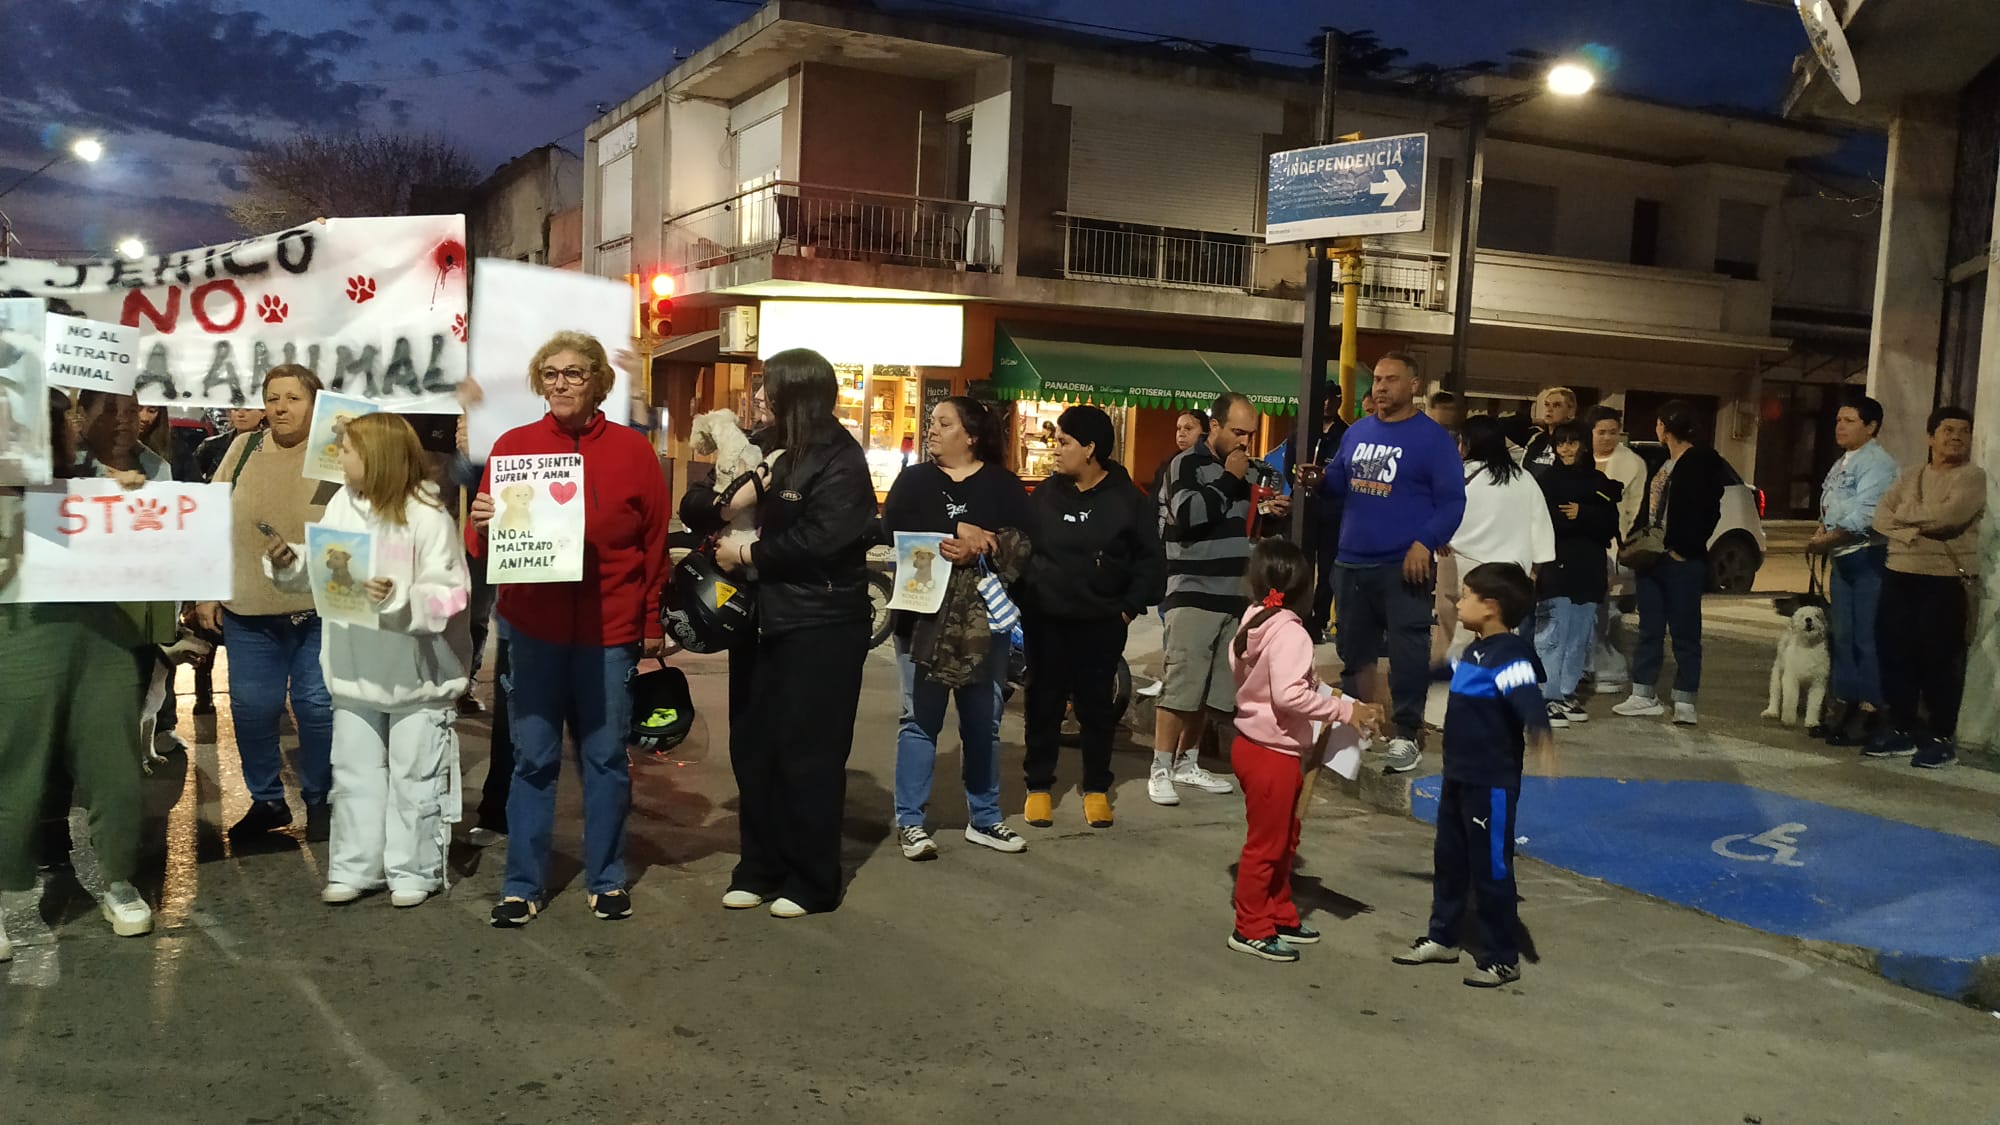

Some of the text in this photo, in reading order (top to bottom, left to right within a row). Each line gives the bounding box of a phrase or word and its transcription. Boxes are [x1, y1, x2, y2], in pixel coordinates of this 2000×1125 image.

[1285, 150, 1403, 177] INDEPENDENCIA
[120, 278, 247, 334] NO
[67, 325, 120, 343] NO AL
[49, 362, 115, 381] ANIMAL
[1044, 381, 1094, 393] PANADERIA
[1129, 387, 1172, 398] ROTISERIA
[496, 456, 581, 472] ELLOS SIENTEN
[1351, 442, 1403, 483] PARIS
[495, 472, 528, 483] SUFREN
[532, 471, 539, 480] Y
[518, 530, 534, 539] AL
[495, 541, 553, 553] MALTRATO
[498, 555, 556, 570] ANIMAL!
